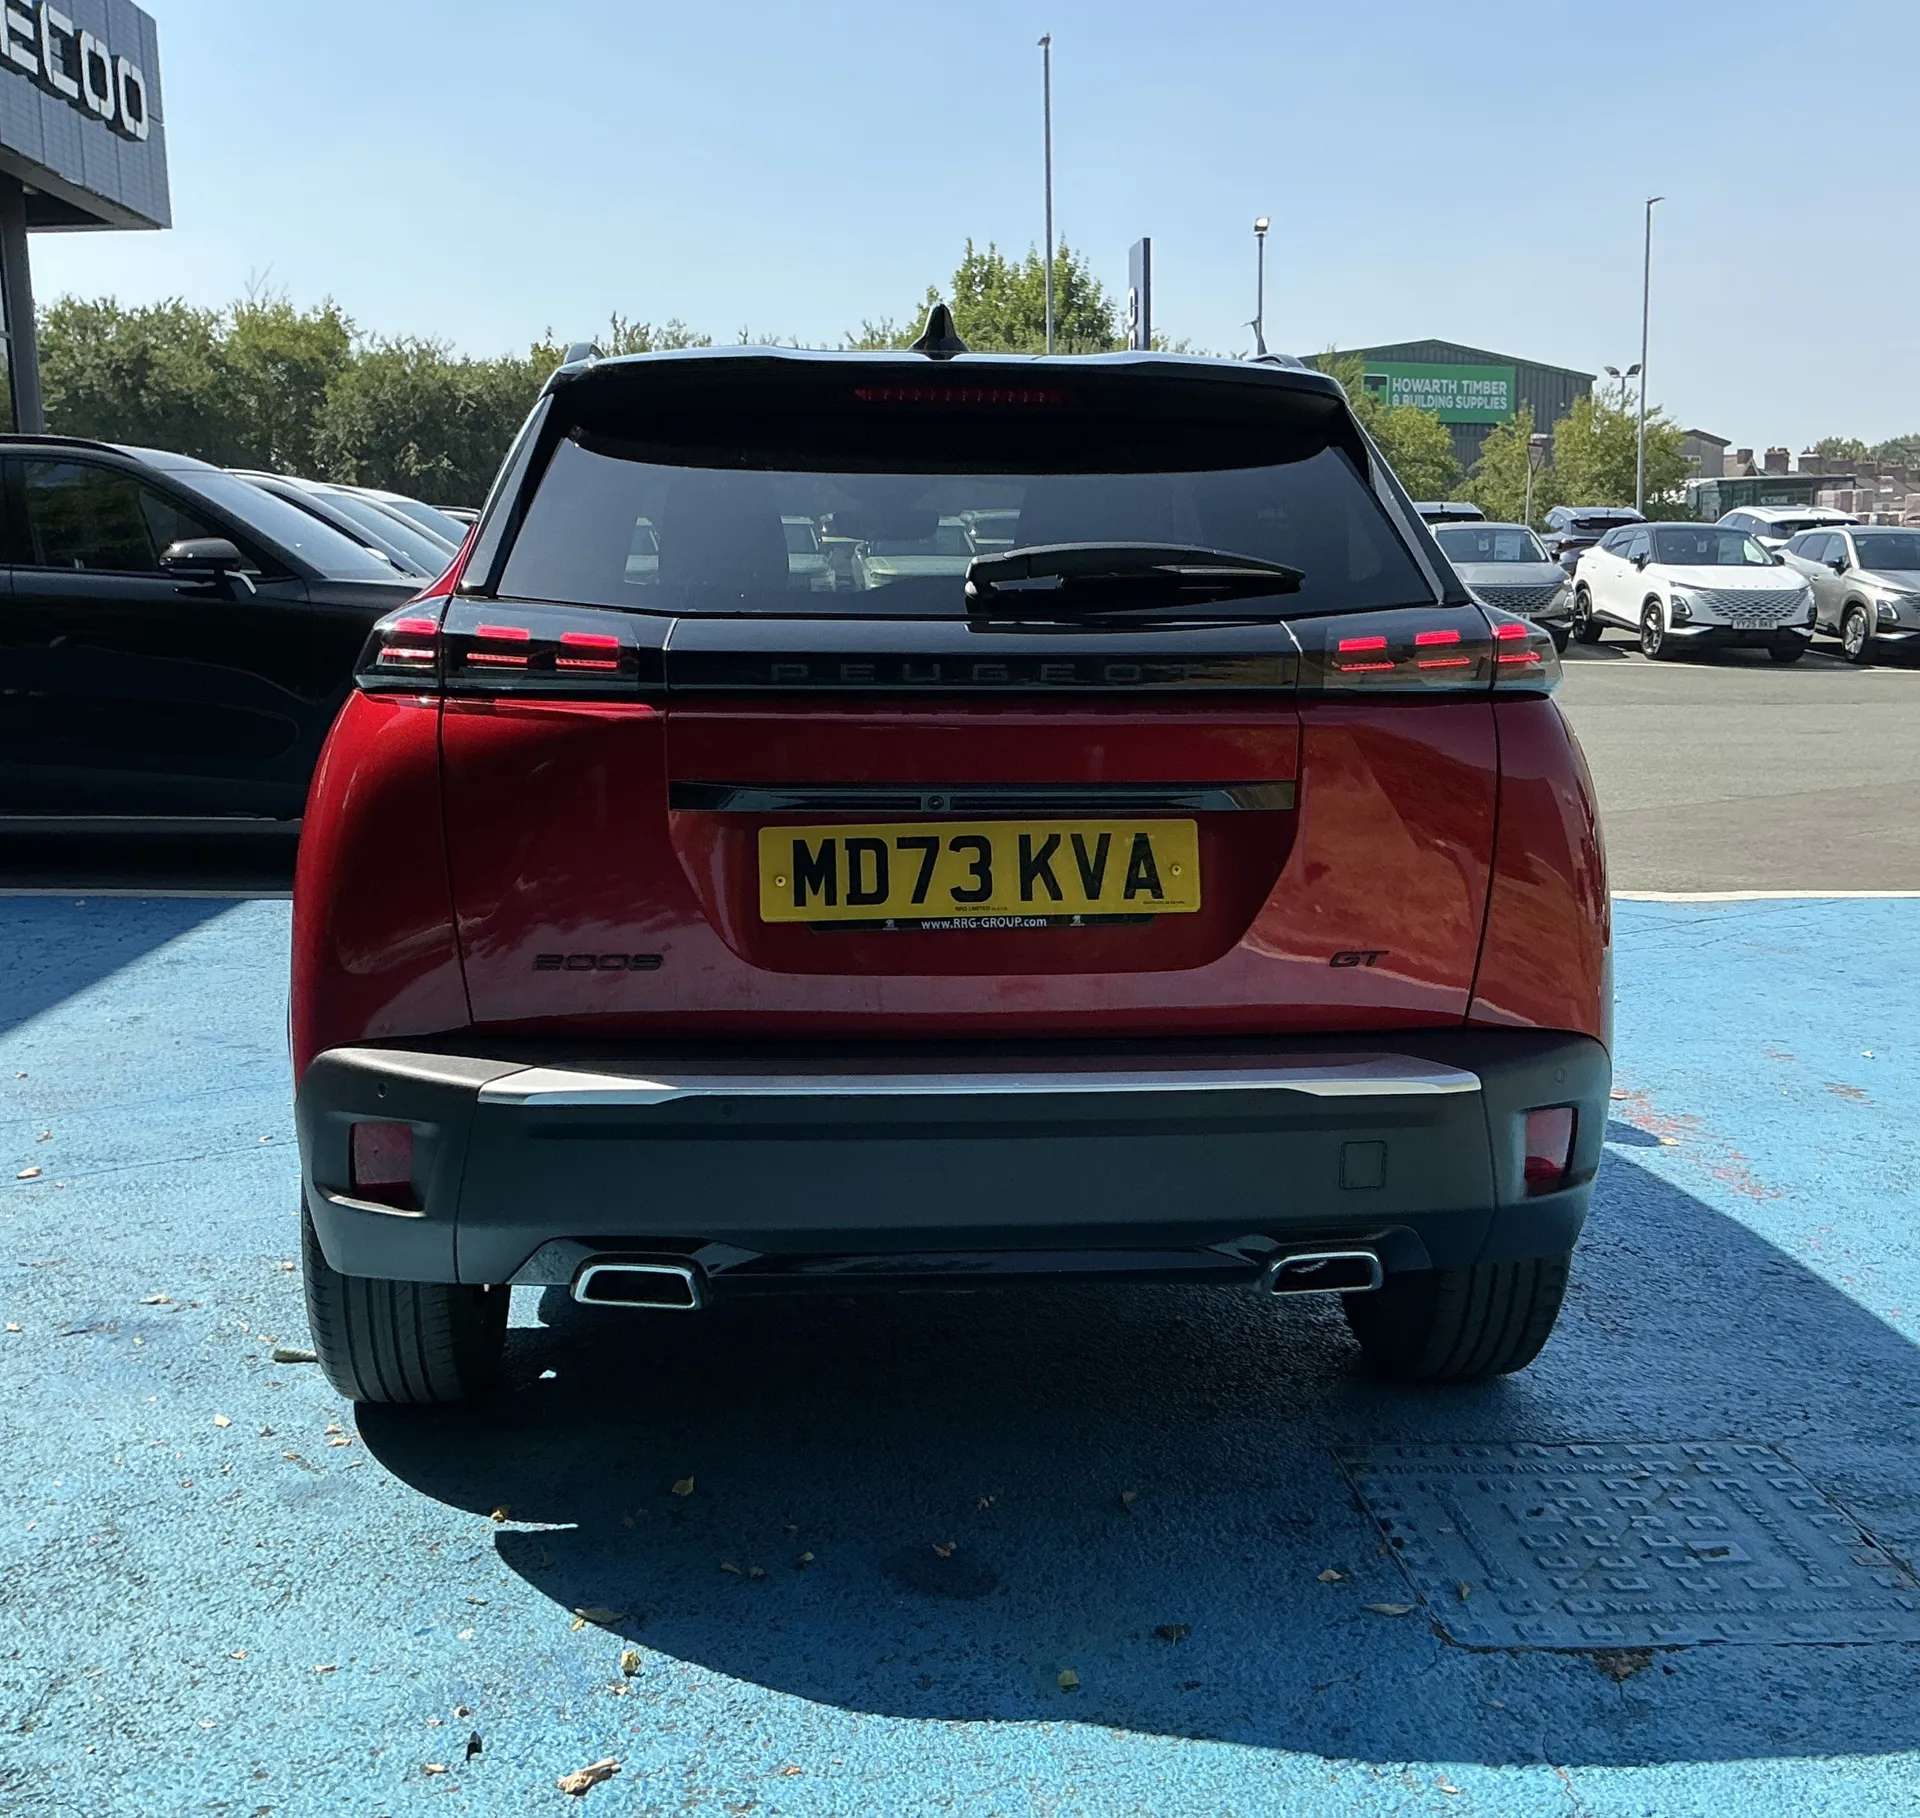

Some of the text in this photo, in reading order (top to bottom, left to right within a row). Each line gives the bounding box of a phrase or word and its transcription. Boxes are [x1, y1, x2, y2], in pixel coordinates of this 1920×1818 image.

[1392, 377, 1507, 395] HOWARTH TIMBER
[1402, 394, 1453, 408] BUILDING
[1455, 395, 1507, 410] SUPPLIES
[770, 663, 1202, 682] PEUGEO
[792, 832, 1164, 907] MD73 KVA
[921, 916, 1047, 930] www.RRG-GROUP.com
[1329, 950, 1390, 968] GT
